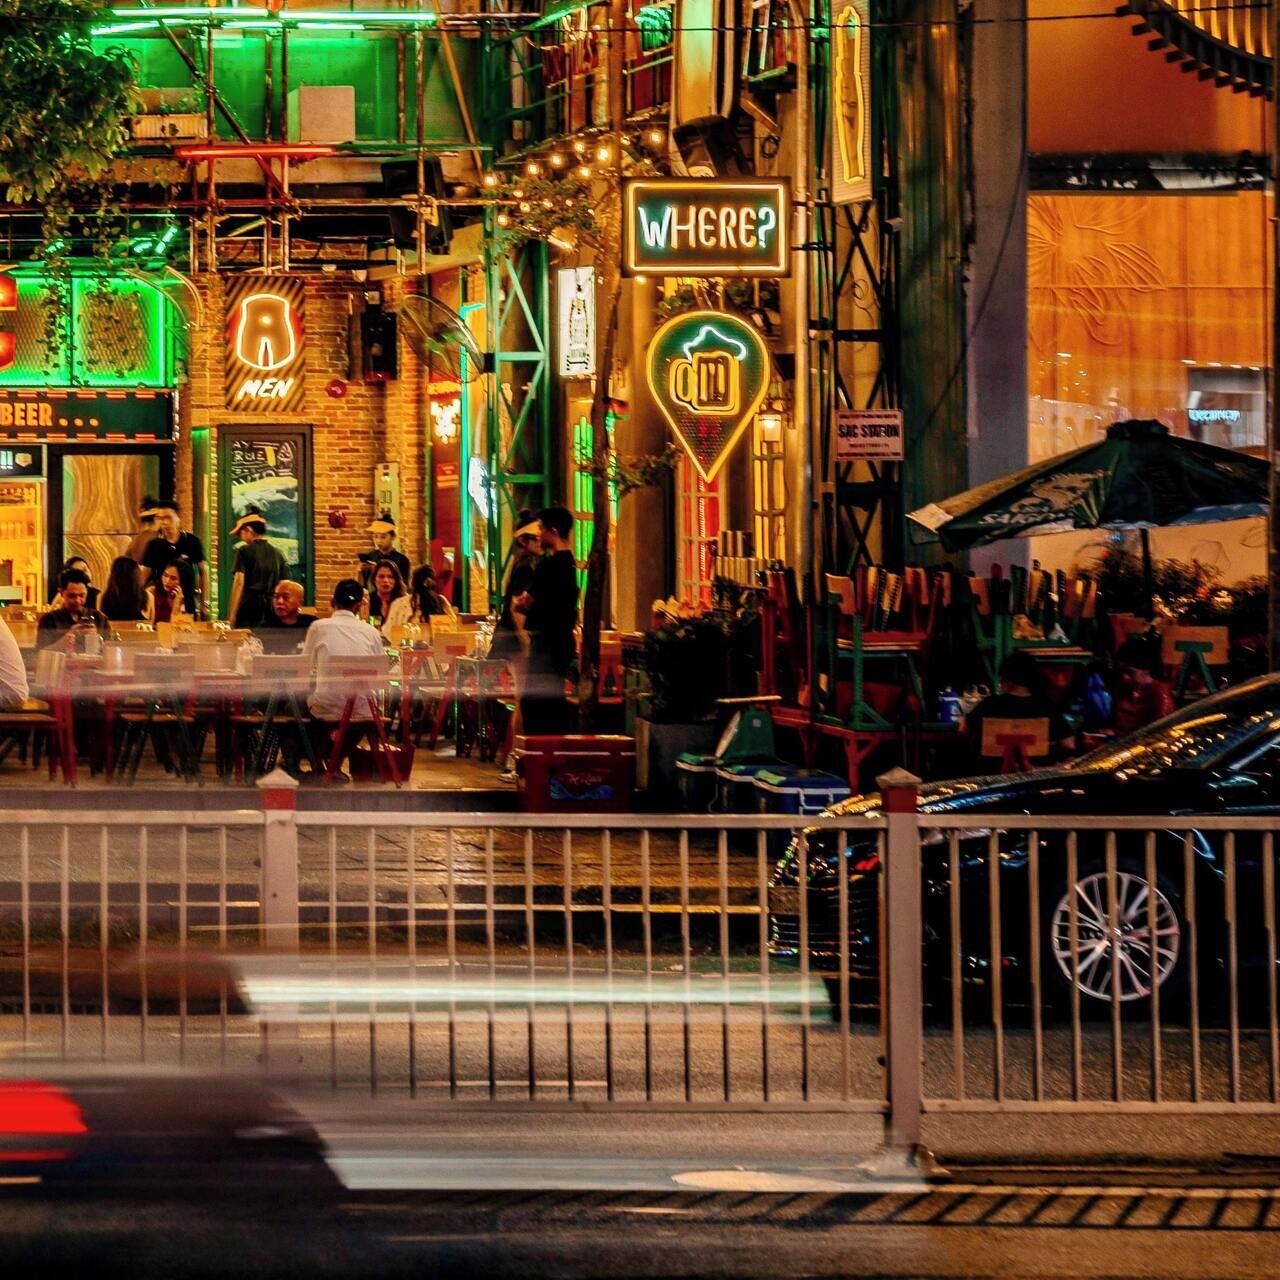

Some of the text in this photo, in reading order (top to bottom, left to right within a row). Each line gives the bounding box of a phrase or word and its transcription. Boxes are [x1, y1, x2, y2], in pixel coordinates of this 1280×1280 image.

[637, 205, 777, 250] WHERE?
[237, 377, 294, 402] MEN
[0, 402, 53, 427] BEER
